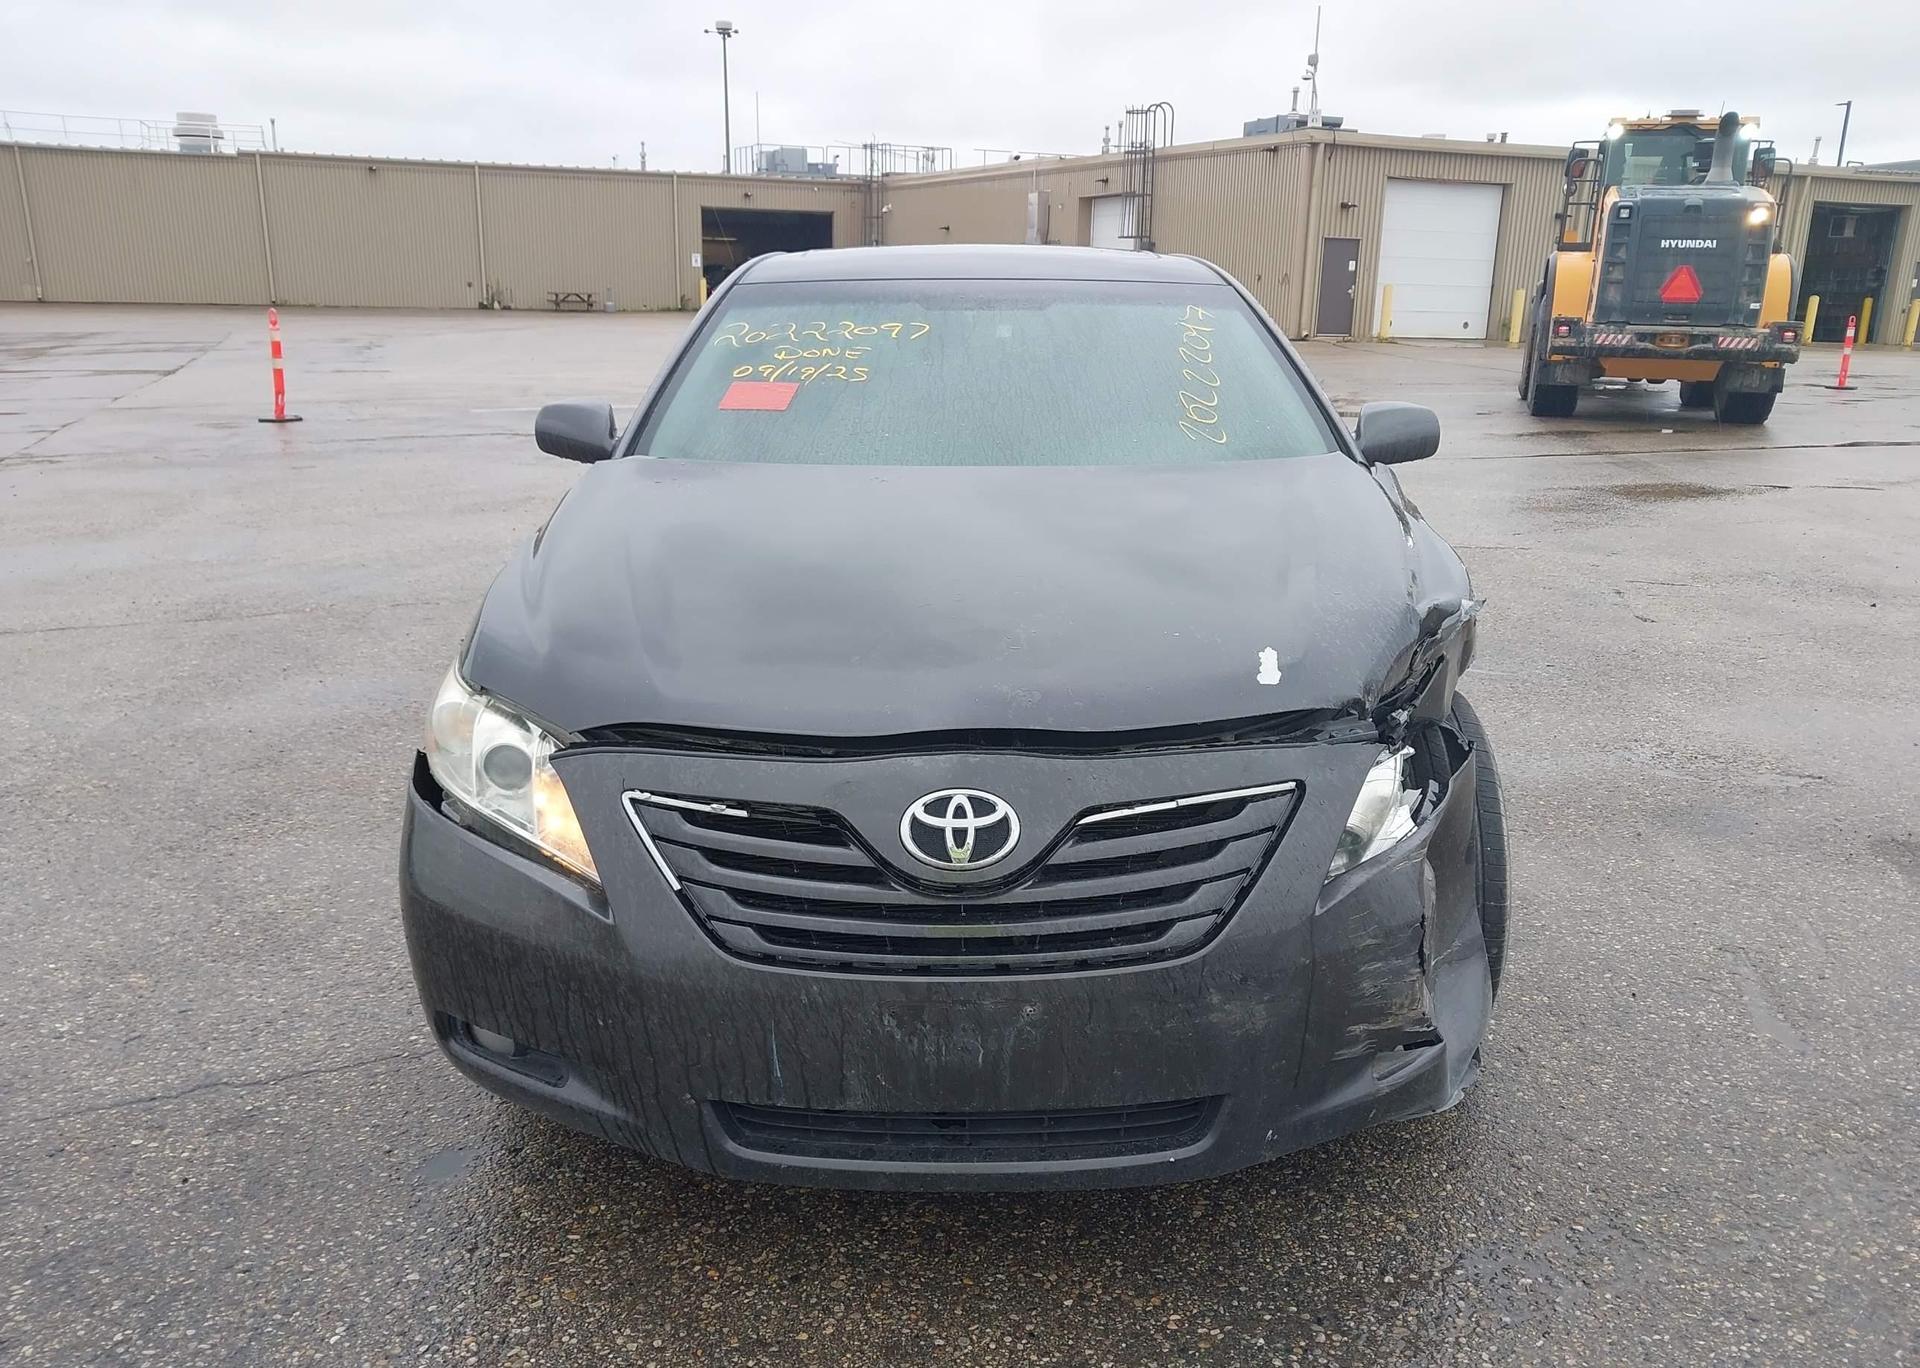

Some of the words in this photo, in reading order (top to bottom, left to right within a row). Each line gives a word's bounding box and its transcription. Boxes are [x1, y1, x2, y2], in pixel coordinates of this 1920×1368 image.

[1660, 239, 1717, 248] HYUNDAI
[715, 321, 930, 347] 20222097
[774, 345, 872, 360] DONE
